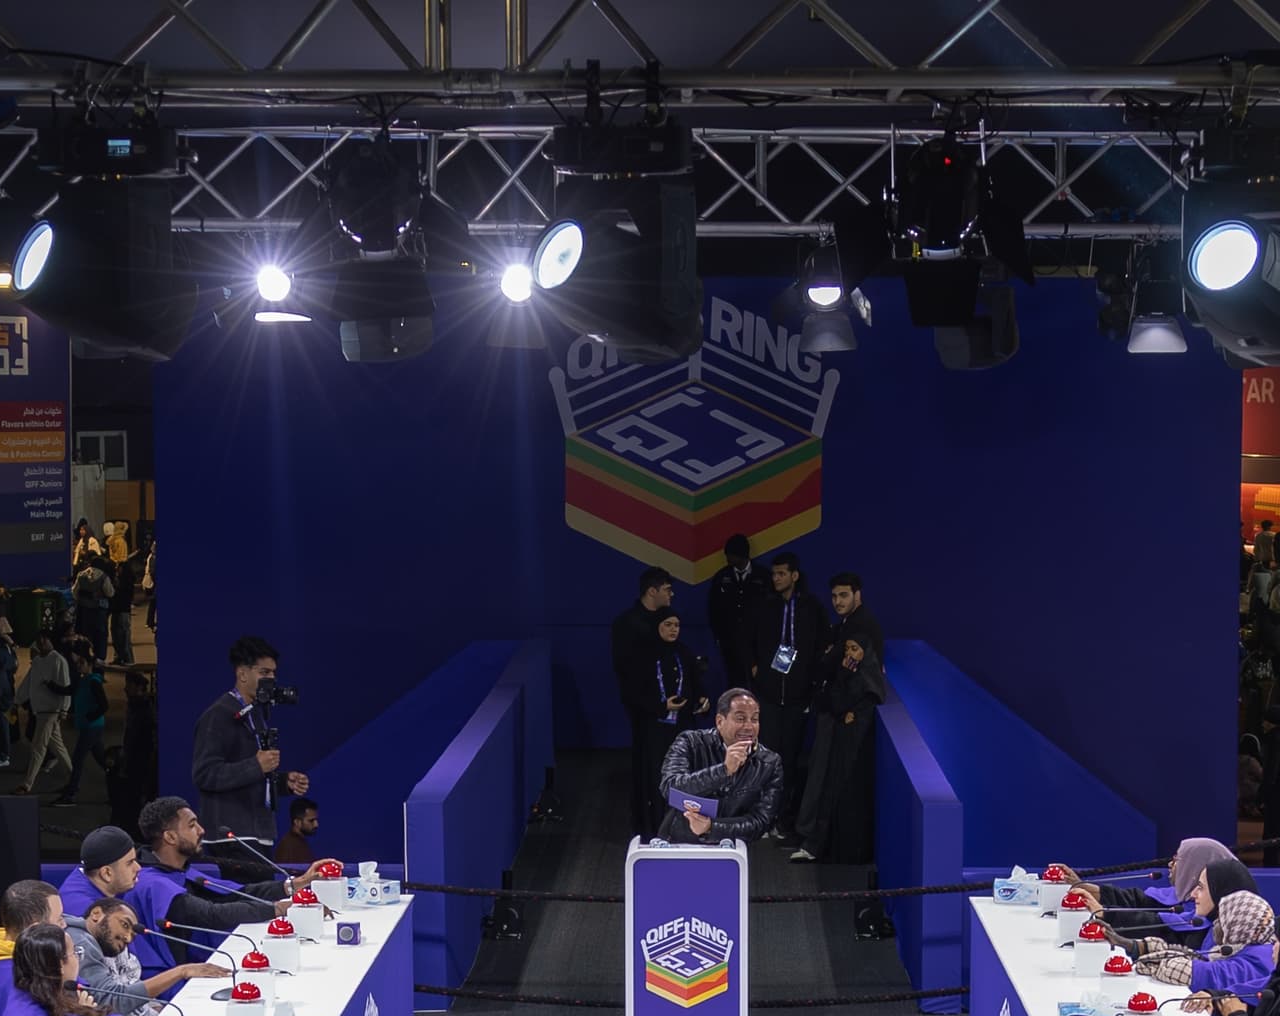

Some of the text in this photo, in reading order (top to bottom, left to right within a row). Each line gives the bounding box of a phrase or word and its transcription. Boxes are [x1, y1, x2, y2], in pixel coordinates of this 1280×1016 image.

[711, 296, 822, 383] RING
[1242, 377, 1275, 404] AR
[30, 510, 63, 520] Main Stage
[31, 534, 44, 542] EXIT
[646, 916, 728, 946] QIFF RING
